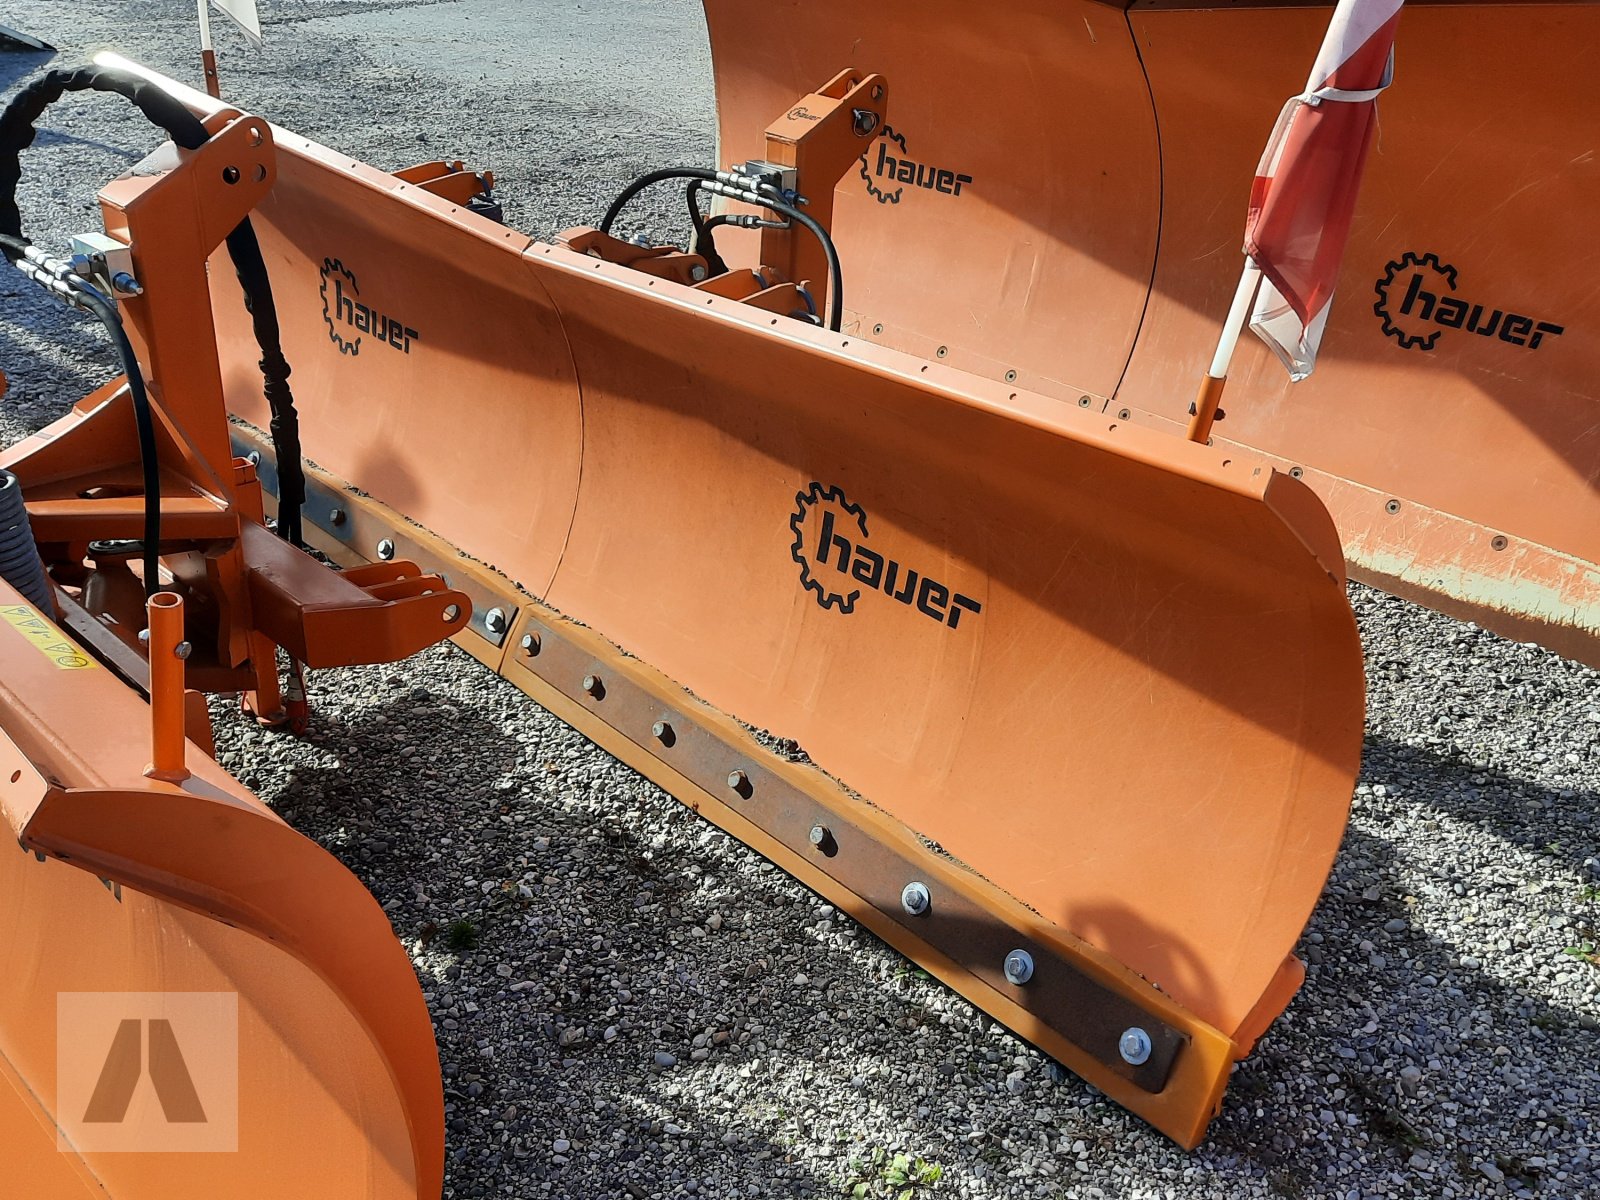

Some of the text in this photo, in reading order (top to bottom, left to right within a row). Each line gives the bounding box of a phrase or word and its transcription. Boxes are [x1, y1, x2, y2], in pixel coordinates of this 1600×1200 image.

[876, 142, 973, 196] hauer
[335, 279, 419, 354] hauer
[1400, 273, 1565, 349] hauer
[816, 510, 982, 629] hauer
